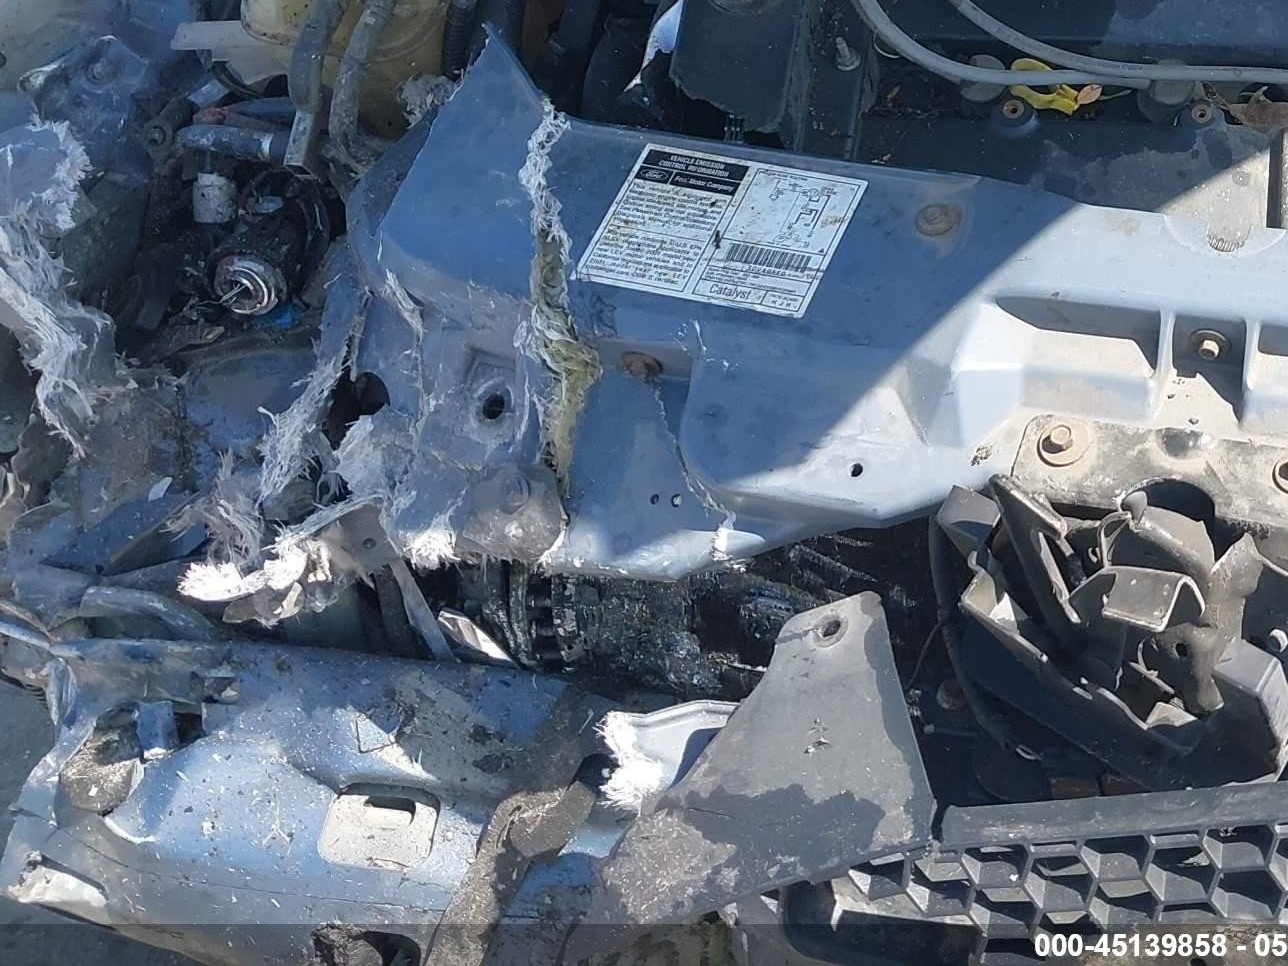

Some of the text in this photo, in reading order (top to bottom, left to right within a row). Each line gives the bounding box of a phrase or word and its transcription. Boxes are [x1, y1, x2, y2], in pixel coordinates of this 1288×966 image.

[657, 159, 730, 177] CONTROL INFORMATION
[668, 154, 726, 169] VEHICLE EMISSION
[704, 180, 736, 193] Company
[706, 282, 753, 301] Catalyst
